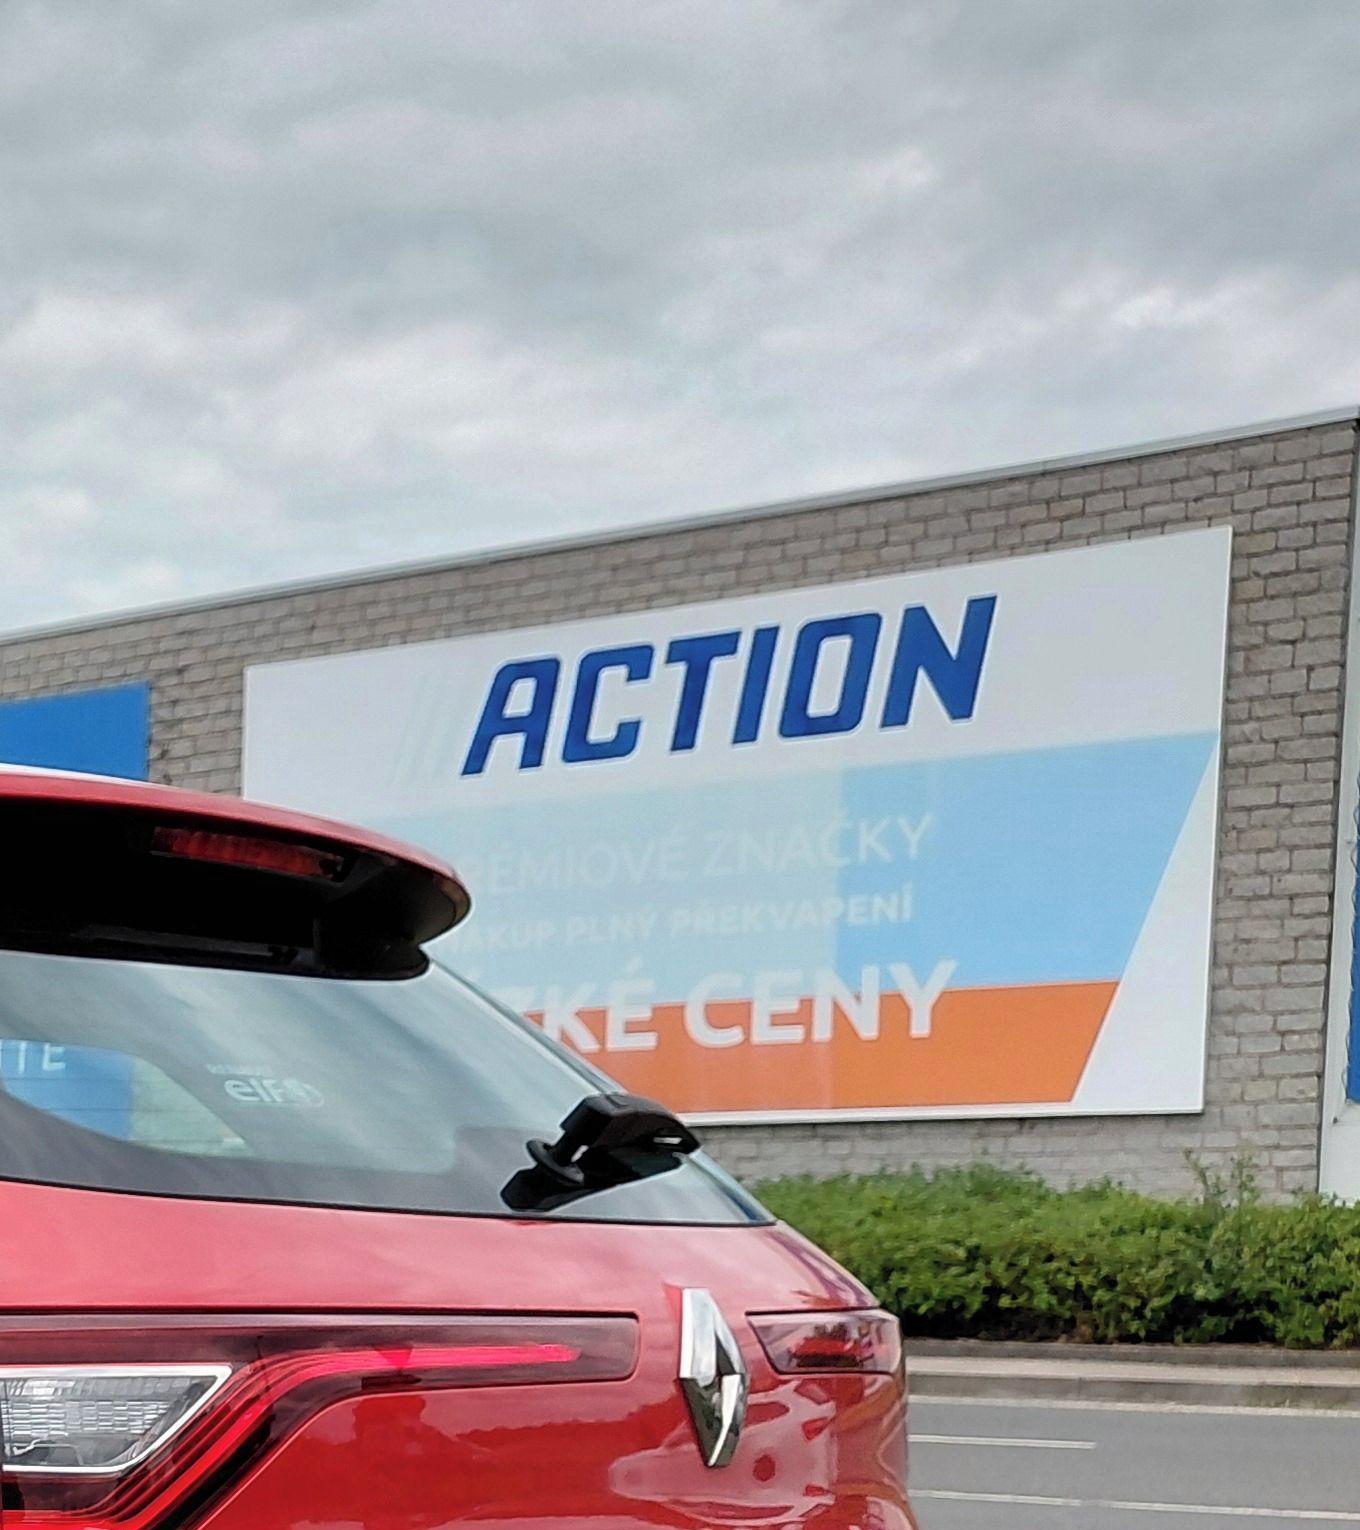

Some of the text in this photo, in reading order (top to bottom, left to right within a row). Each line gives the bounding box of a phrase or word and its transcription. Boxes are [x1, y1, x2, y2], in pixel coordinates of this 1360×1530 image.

[460, 594, 998, 777] ACTION
[702, 810, 935, 877] ZNAČKY
[682, 958, 959, 1048] CENY
